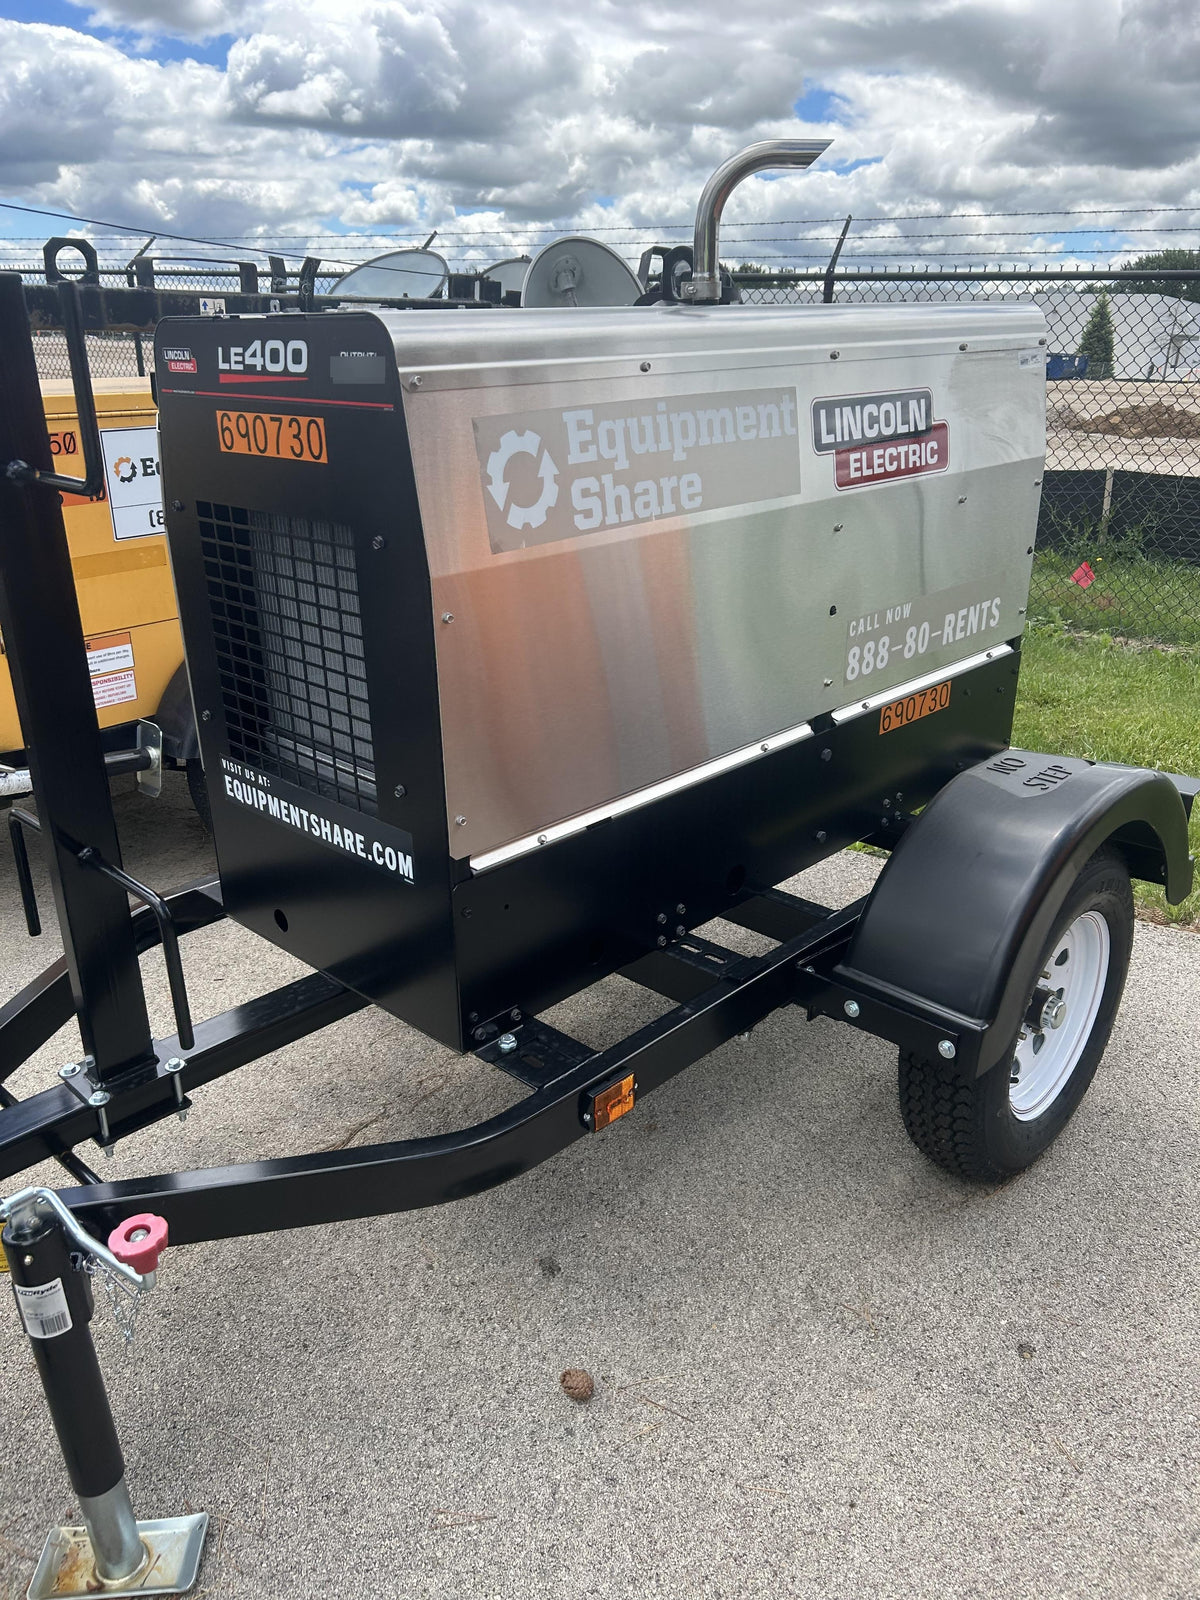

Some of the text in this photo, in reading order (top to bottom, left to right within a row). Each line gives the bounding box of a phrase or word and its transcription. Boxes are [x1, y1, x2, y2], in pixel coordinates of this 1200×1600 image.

[164, 349, 190, 361] LINCOLN
[171, 361, 195, 371] ELECTRIC
[217, 339, 308, 373] LE400
[220, 412, 323, 461] 690730
[561, 394, 797, 471] Equipment
[819, 398, 926, 444] LINCOLN
[849, 440, 938, 479] ELECTRIC
[570, 472, 703, 531] Share
[846, 597, 1001, 680] 888-80-RENTS
[849, 602, 912, 637] CALL NOW
[881, 683, 950, 732] 690730
[222, 758, 271, 788] VISIT US AT:
[986, 757, 1027, 775] NO
[1022, 765, 1073, 790] STEP
[224, 774, 414, 880] EQUIPMENTSHARE.COM
